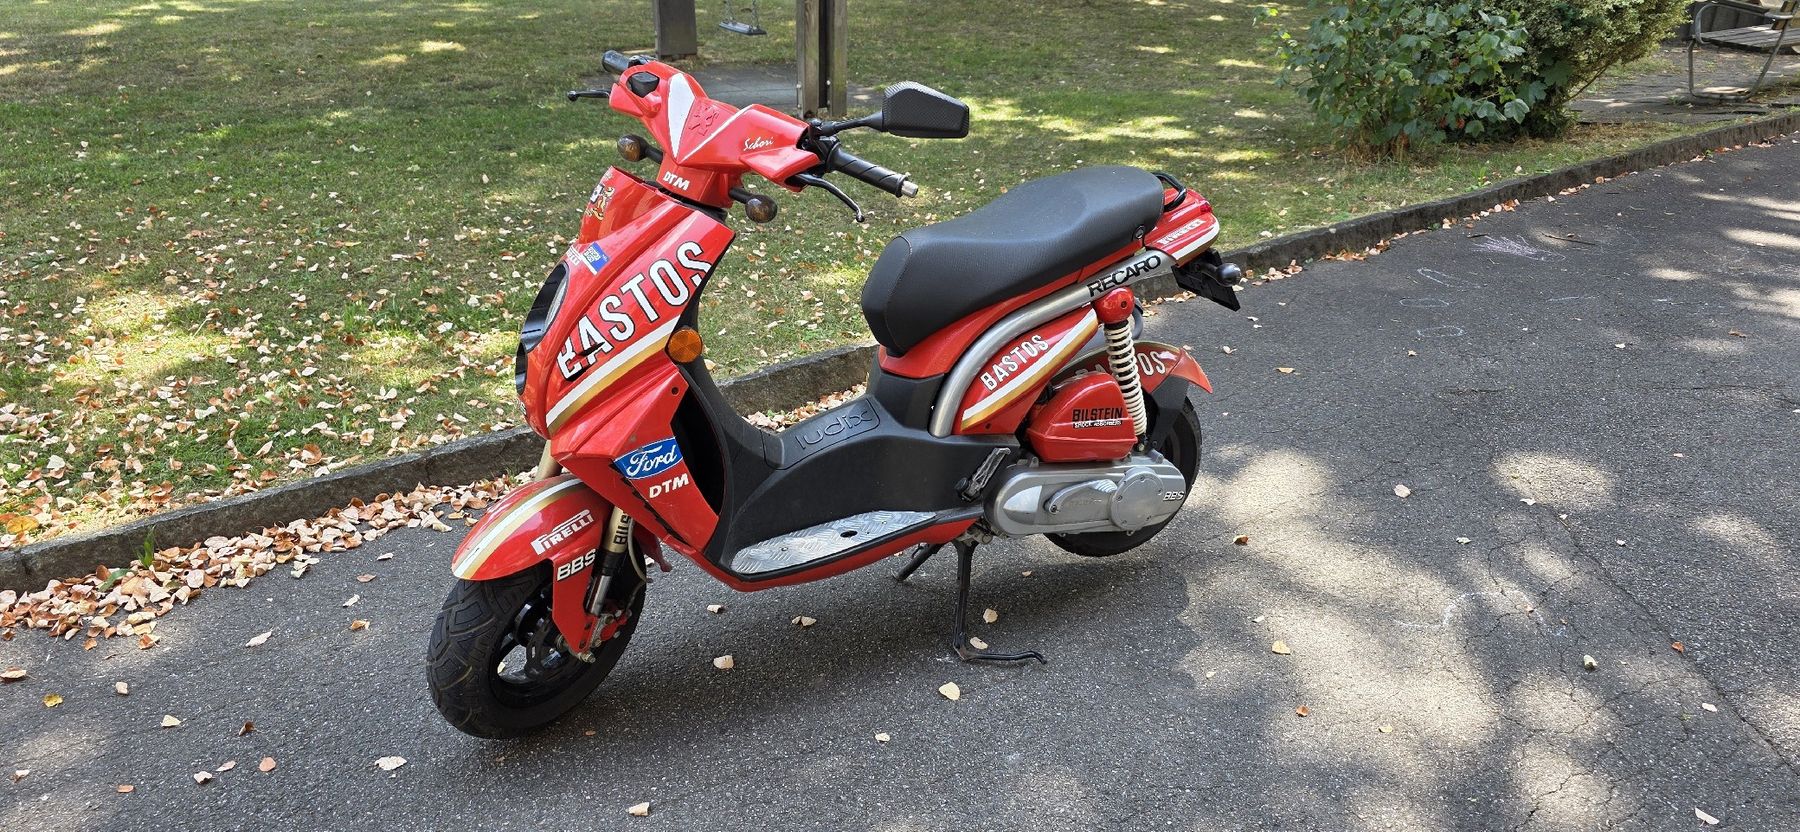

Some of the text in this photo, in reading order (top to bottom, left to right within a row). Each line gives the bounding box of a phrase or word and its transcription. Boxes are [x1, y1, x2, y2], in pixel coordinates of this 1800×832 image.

[663, 171, 690, 191] DTM
[1086, 255, 1161, 297] RECARO
[980, 334, 1049, 391] BASTOS
[1072, 407, 1123, 422] BILSTEIN
[626, 444, 677, 477] Ford
[649, 472, 690, 499] DTM
[1163, 491, 1184, 501] BBS
[530, 509, 594, 556] PIRELLI
[556, 548, 597, 582] BBS
